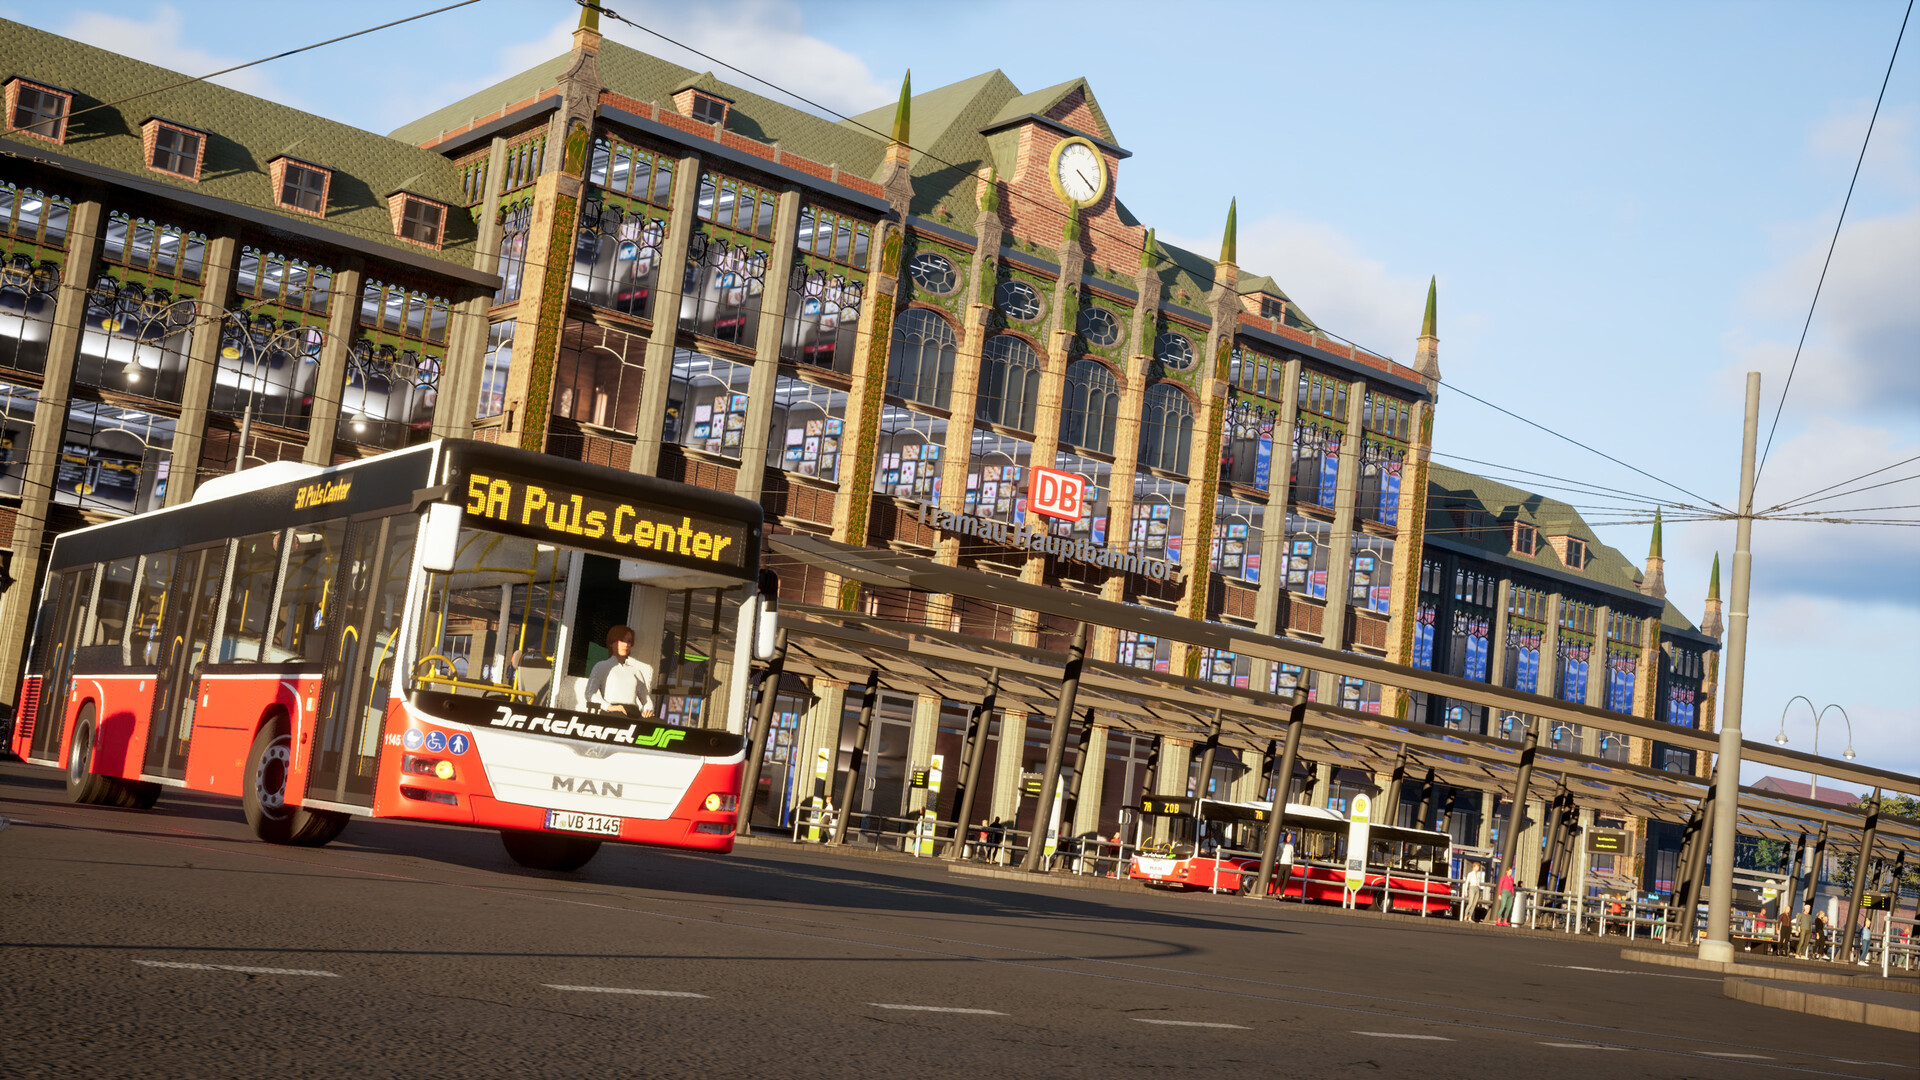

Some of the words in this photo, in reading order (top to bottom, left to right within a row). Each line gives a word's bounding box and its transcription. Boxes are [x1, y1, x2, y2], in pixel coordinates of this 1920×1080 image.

[295, 487, 307, 509] 5A
[304, 484, 324, 507] Puls
[323, 478, 352, 503] Center
[1039, 473, 1078, 513] DB
[467, 473, 511, 520] 5A
[521, 485, 607, 538] Puls
[612, 504, 732, 561] Center
[917, 498, 1007, 543] Tramau
[1013, 521, 1175, 581] Hauptbahnhof
[385, 733, 402, 746] 1145
[551, 775, 623, 798] MAN
[1143, 801, 1152, 812] 7A
[1164, 803, 1180, 814] ZOB
[552, 812, 560, 826] T
[568, 815, 584, 829] VB
[587, 817, 620, 833] 1145
